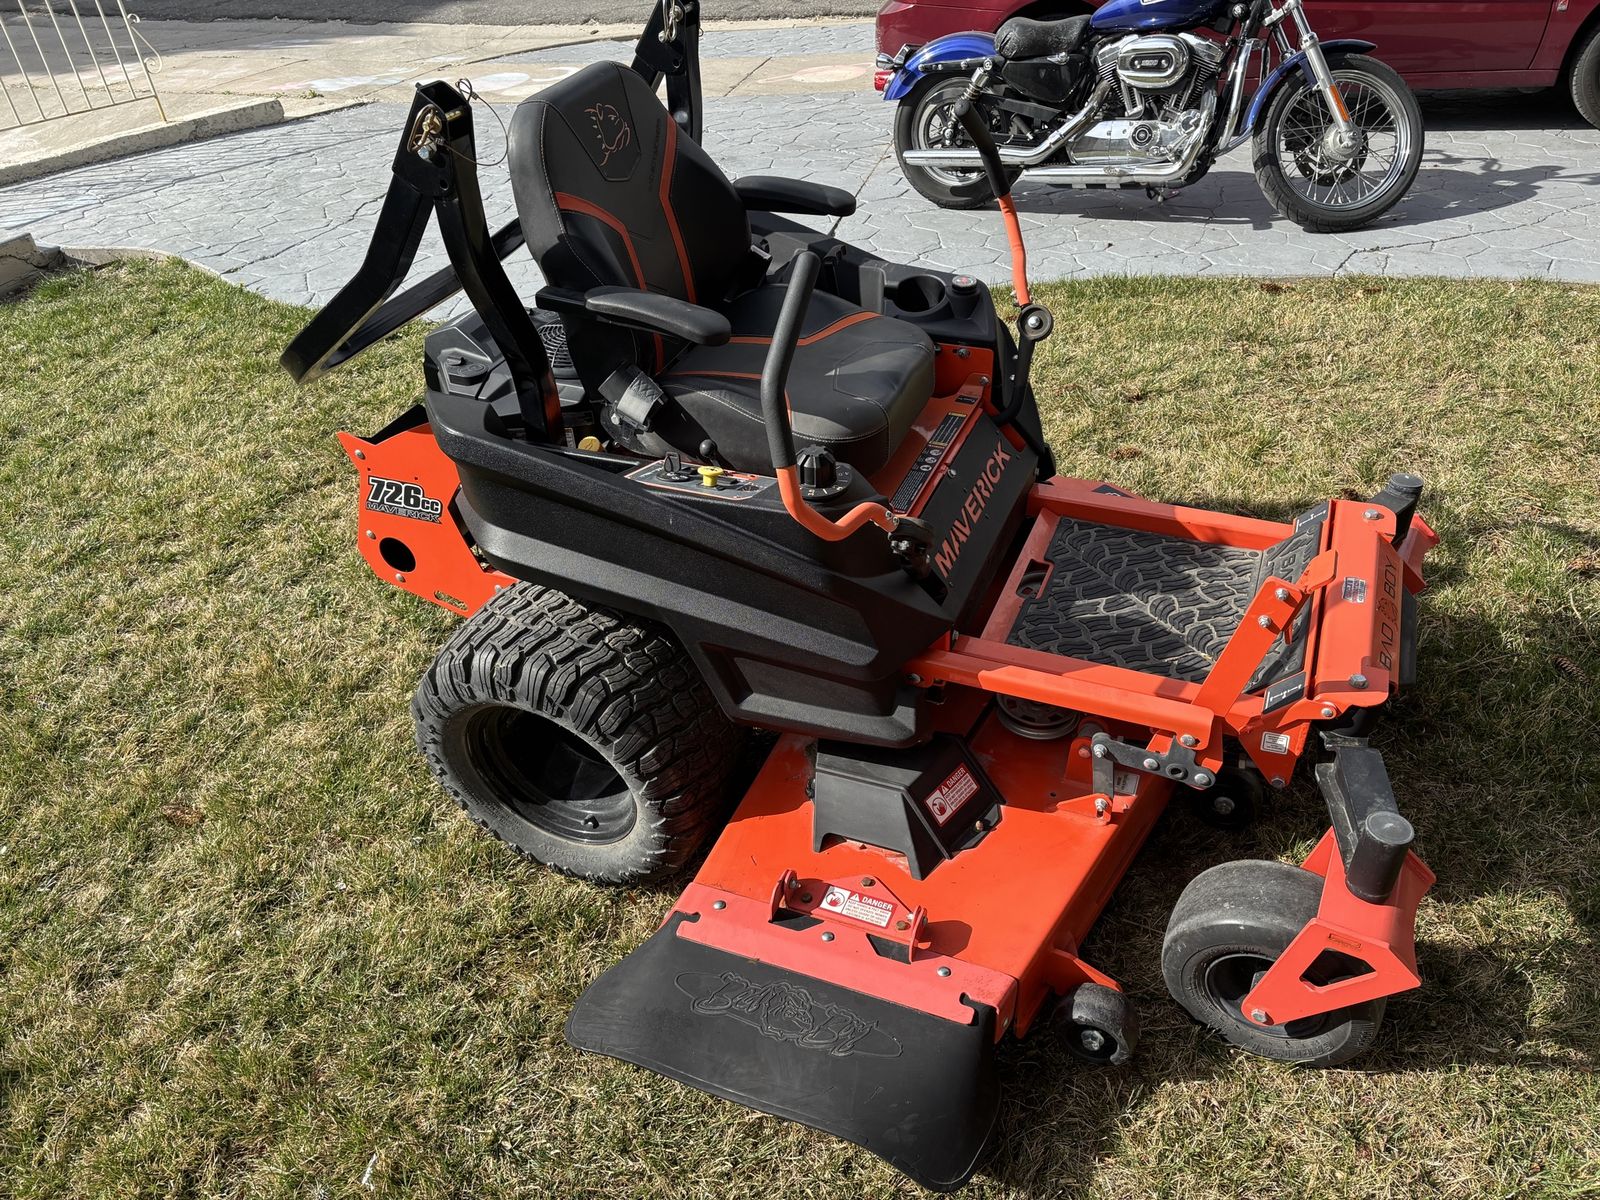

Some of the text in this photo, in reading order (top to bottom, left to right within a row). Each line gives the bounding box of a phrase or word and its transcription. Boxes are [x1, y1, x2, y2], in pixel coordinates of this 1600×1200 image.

[366, 501, 442, 524] MAVERICK
[934, 440, 1012, 578] MAVERICK
[1380, 555, 1397, 671] BAD BOY
[946, 767, 966, 788] DANGER
[861, 896, 893, 911] DANGER
